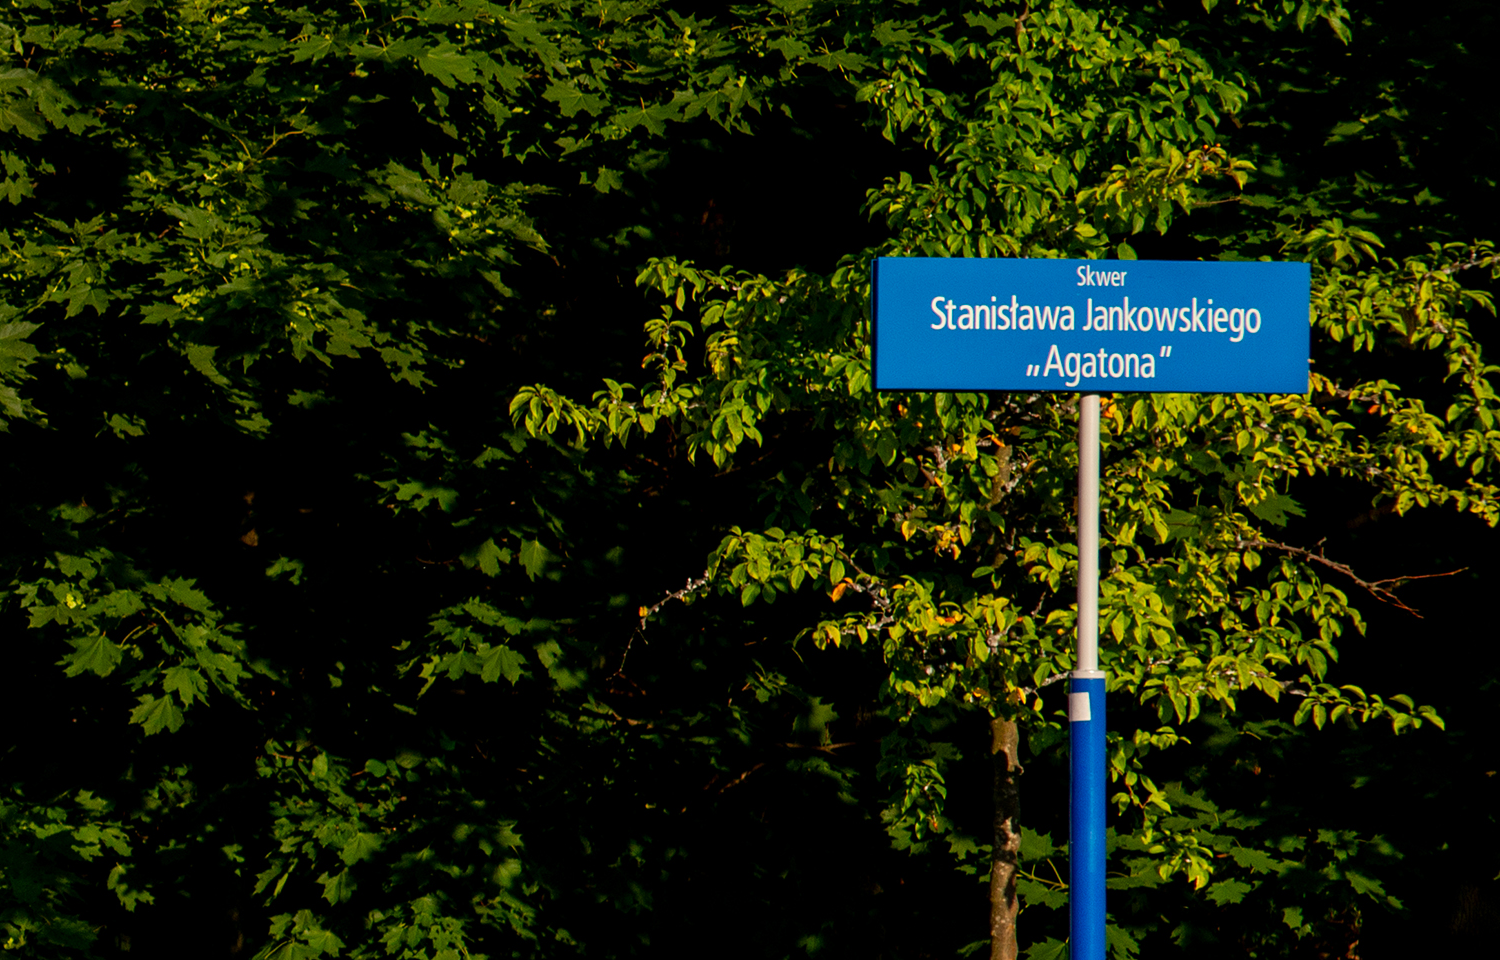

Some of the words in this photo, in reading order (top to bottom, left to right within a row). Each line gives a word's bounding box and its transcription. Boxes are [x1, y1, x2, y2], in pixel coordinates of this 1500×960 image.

[1077, 265, 1127, 287] Skwer
[930, 295, 1075, 331] Stanisława
[1082, 296, 1262, 343] Jankowskiego
